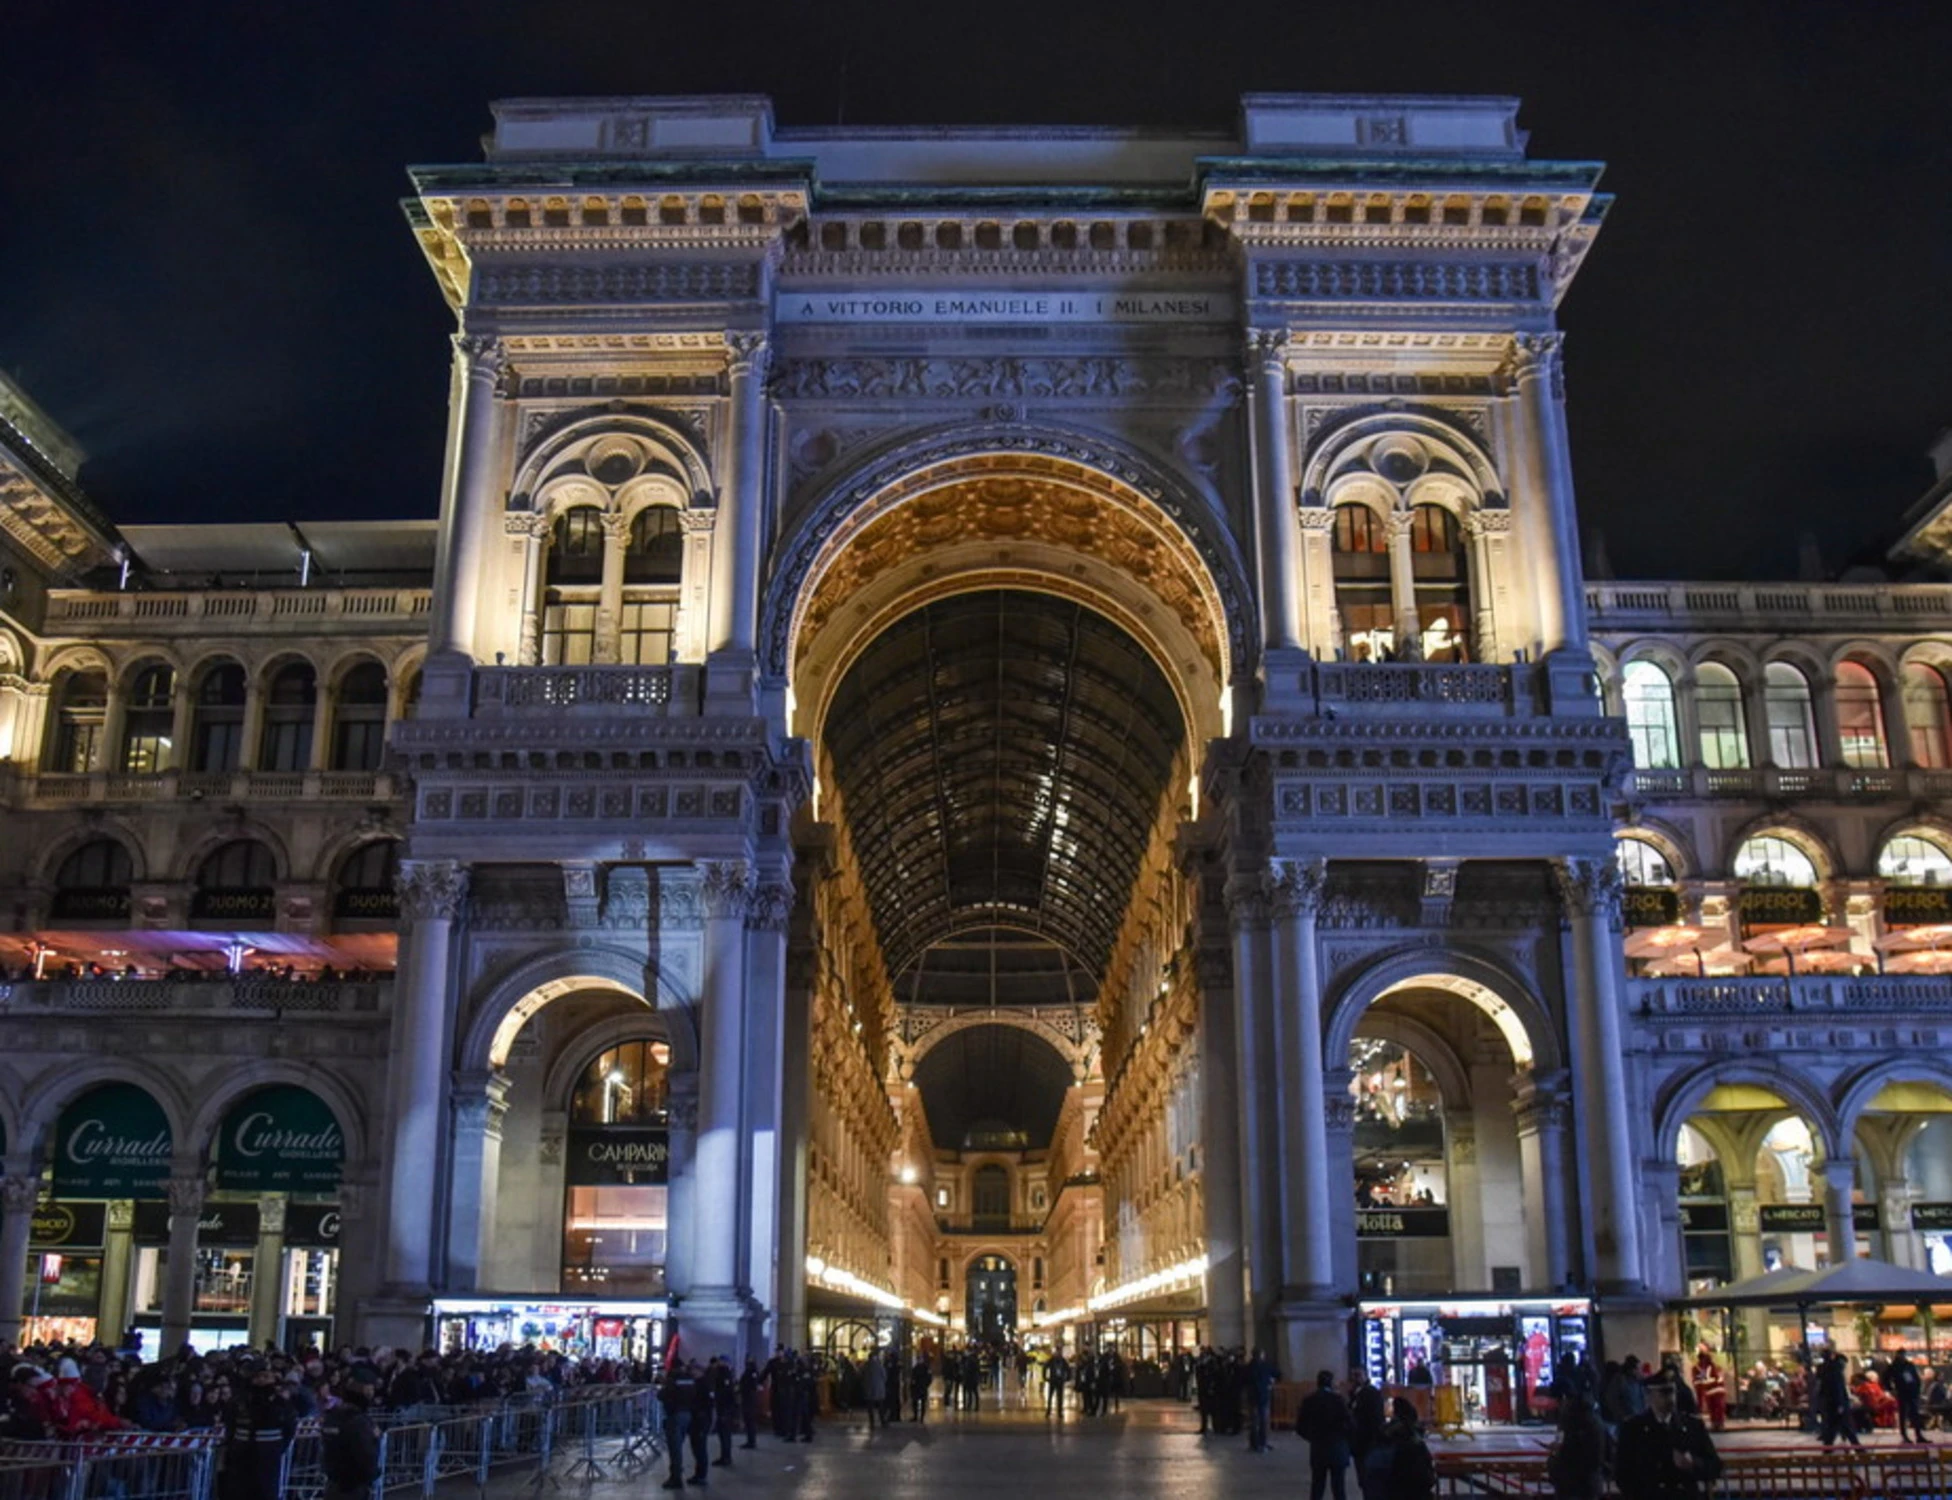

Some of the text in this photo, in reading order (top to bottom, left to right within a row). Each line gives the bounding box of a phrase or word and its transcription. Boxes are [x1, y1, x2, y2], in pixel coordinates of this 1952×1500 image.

[801, 302, 814, 315] A
[828, 301, 923, 315] VITTORIO
[935, 301, 1049, 315] EMANUELE
[1113, 301, 1210, 315] MILANESI
[207, 895, 258, 909] DUOMO
[348, 894, 392, 909] DUOM
[1622, 893, 1666, 911] EROL
[66, 1118, 172, 1165] Currado
[235, 1111, 341, 1158] Currado
[588, 1142, 667, 1162] CAMPARIN
